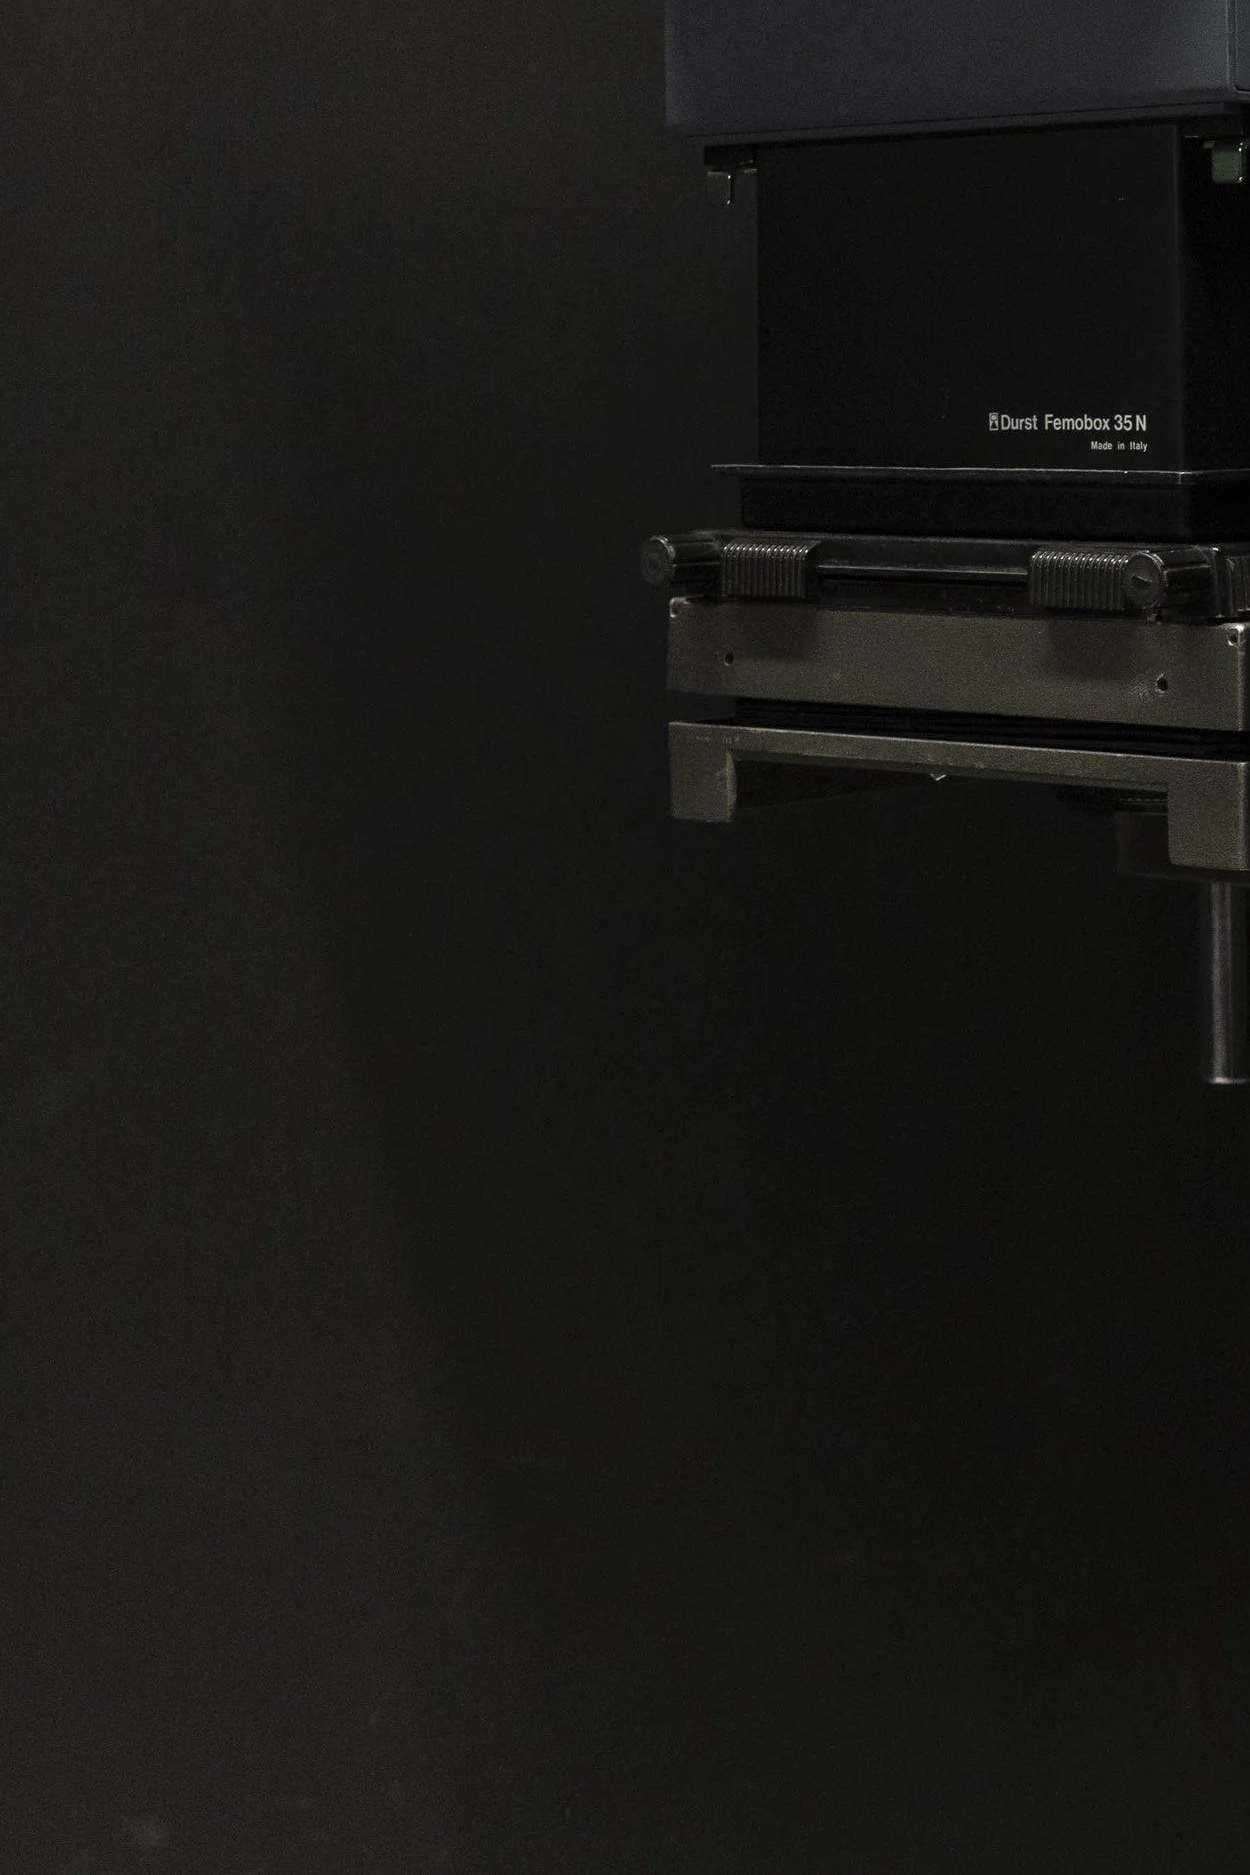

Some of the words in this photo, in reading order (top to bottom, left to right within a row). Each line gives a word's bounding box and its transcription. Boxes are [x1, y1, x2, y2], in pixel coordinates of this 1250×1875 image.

[1000, 413, 1038, 431] Durst
[1044, 413, 1110, 431] Femobox
[1113, 414, 1133, 431] 35
[1135, 414, 1147, 431] N
[1090, 440, 1113, 451] Made
[1117, 441, 1125, 451] in
[1129, 441, 1148, 452] Italy
